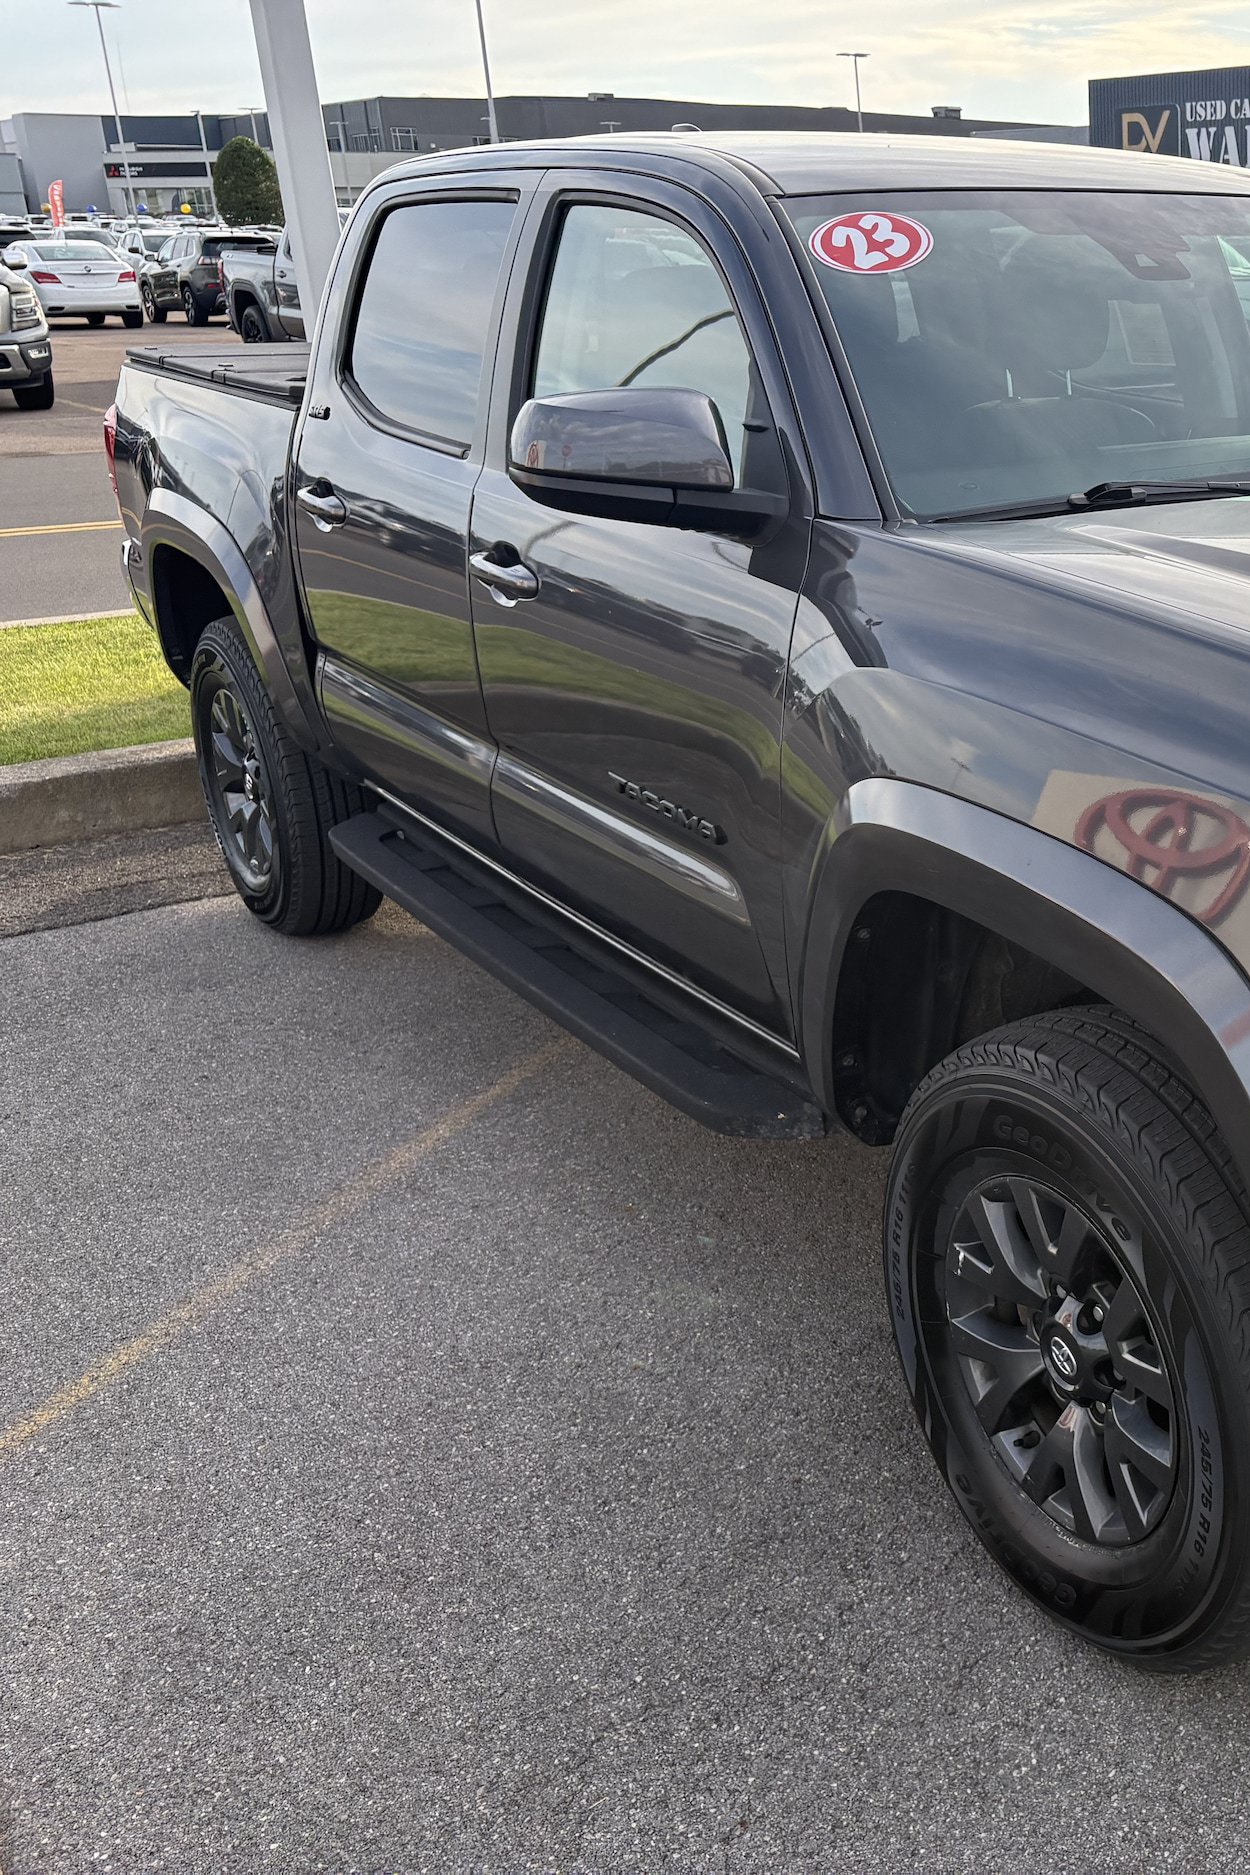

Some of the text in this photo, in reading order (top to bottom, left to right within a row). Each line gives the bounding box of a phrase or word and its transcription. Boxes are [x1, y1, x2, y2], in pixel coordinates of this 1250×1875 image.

[1185, 100, 1227, 122] USED
[831, 214, 911, 270] 23
[607, 771, 727, 845] TACOMA
[1198, 1425, 1213, 1513] 245/75
[1193, 1517, 1211, 1558] R16
